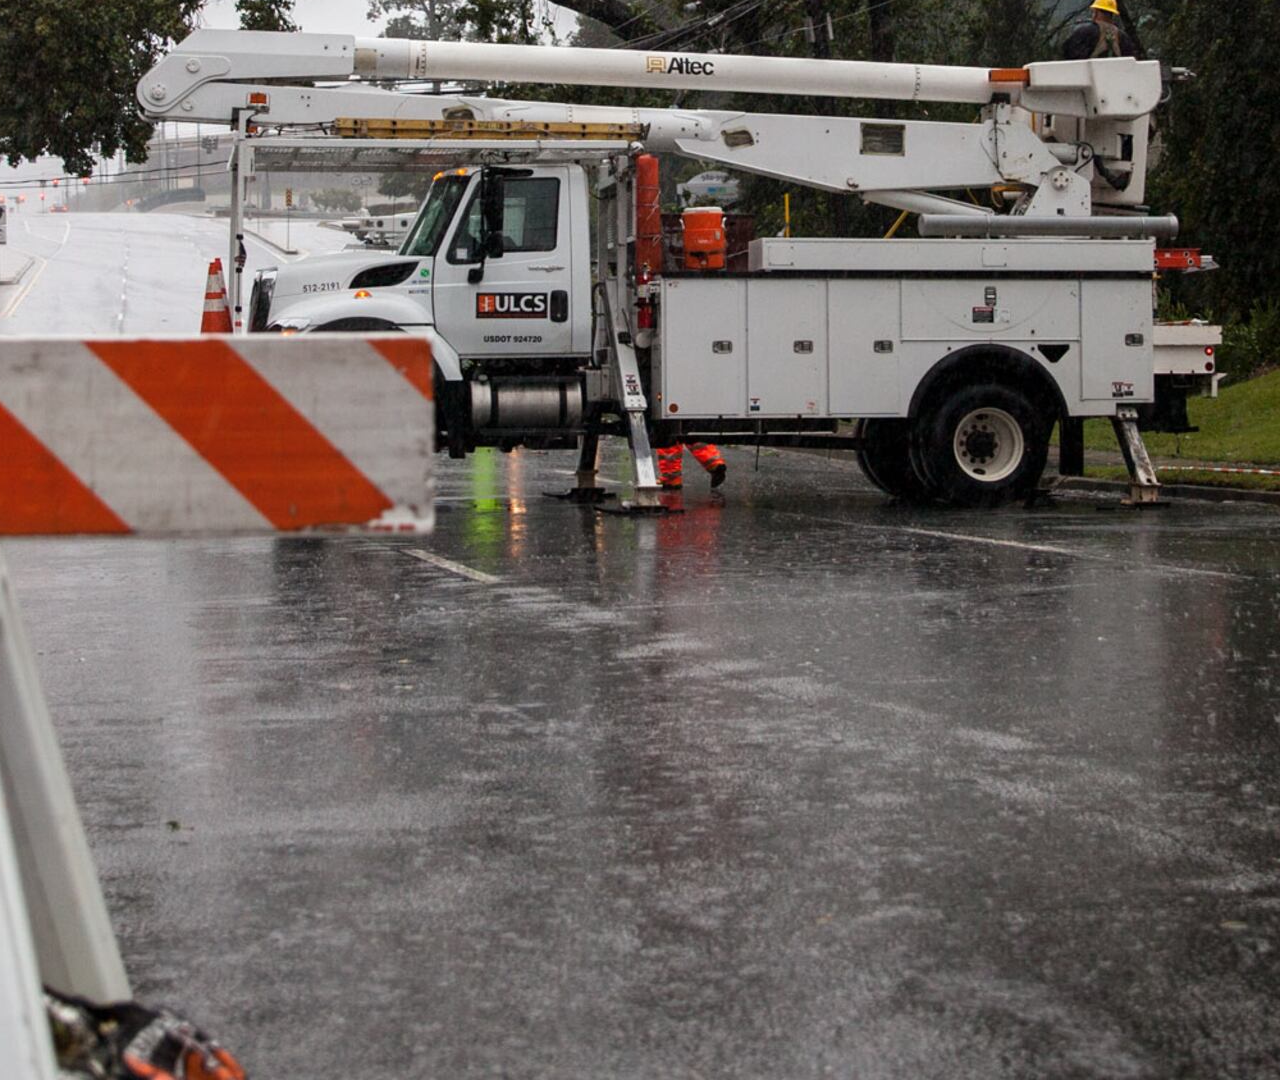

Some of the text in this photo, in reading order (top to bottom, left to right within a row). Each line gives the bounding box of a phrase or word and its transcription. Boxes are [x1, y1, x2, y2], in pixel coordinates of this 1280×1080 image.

[667, 57, 714, 75] Altec
[302, 281, 340, 293] 512-2191
[495, 295, 545, 312] ULCS
[483, 335, 542, 343] USDOT 924720
